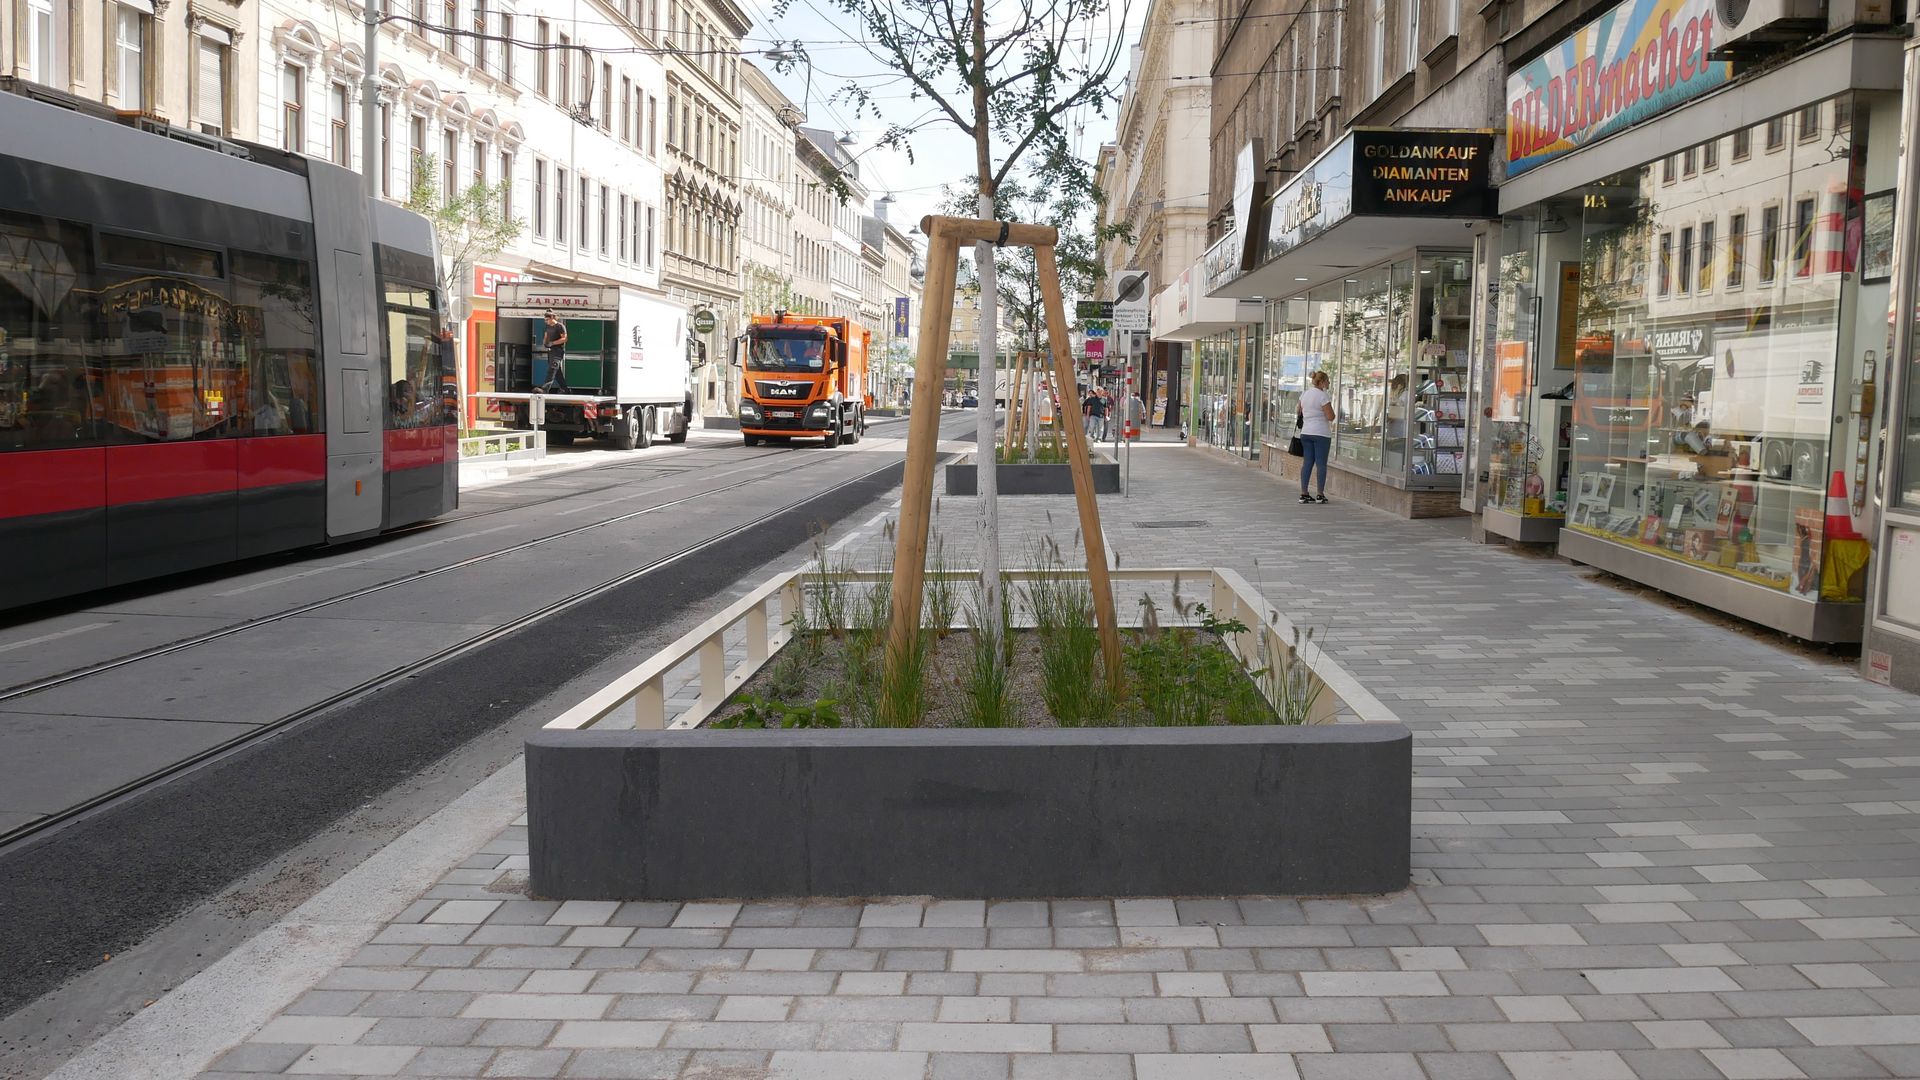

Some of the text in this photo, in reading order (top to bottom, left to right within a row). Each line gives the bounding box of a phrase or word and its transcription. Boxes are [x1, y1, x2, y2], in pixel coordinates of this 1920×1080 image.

[1510, 8, 1713, 161] BILDERmacher
[1364, 145, 1478, 160] GOLDANKAUF
[1372, 166, 1469, 181] DIAMANTEN
[1384, 188, 1451, 202] ANKAUF
